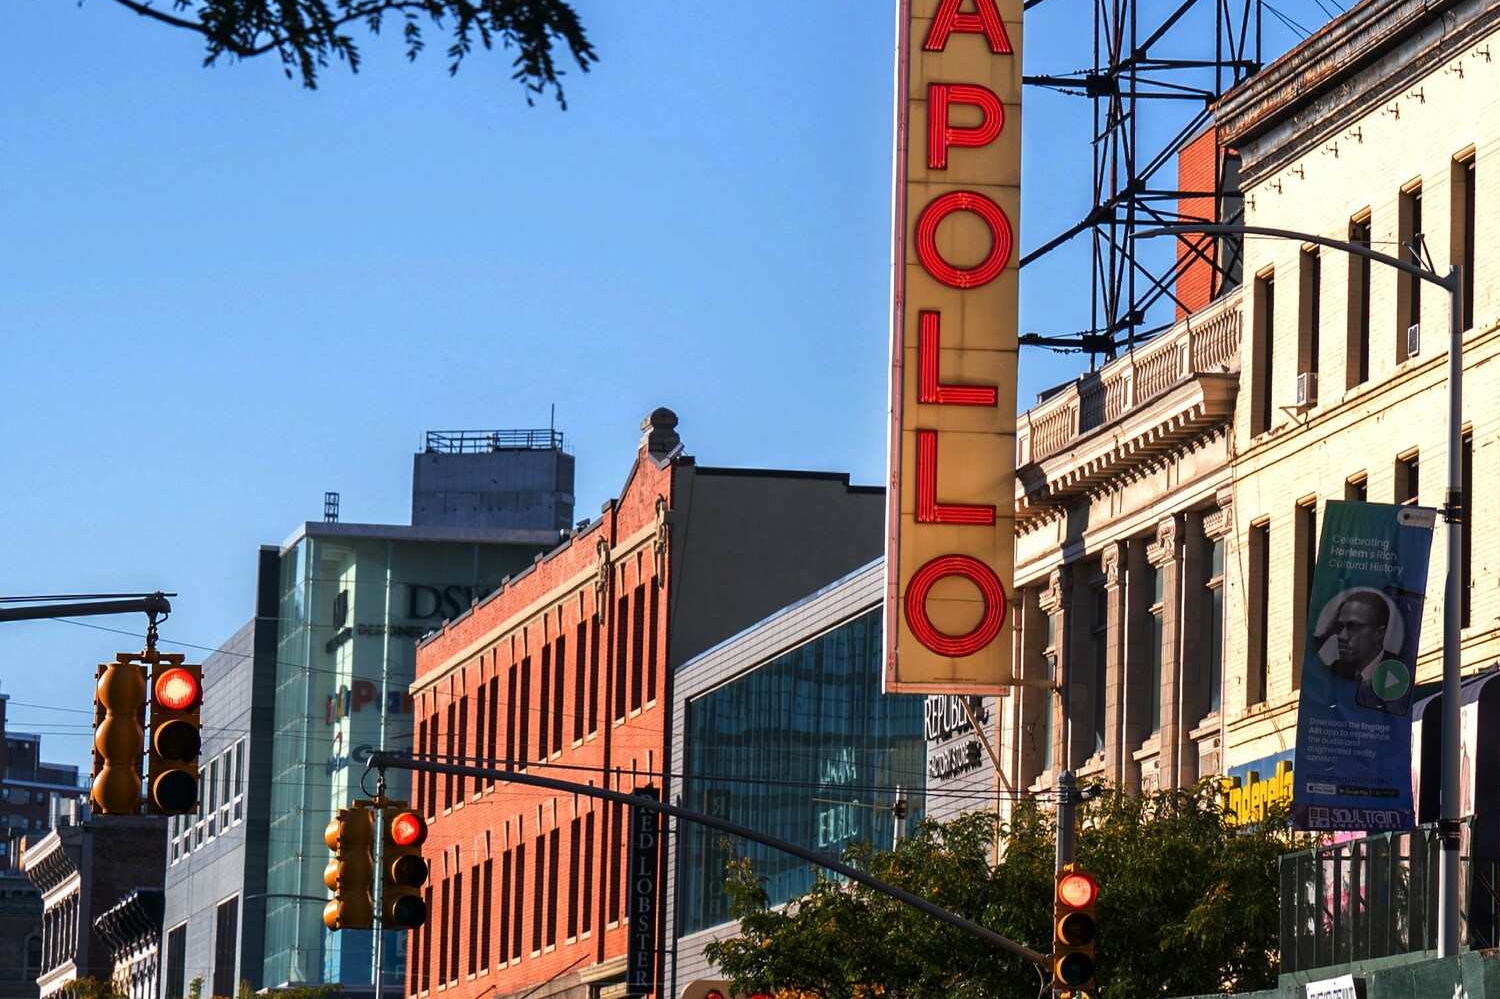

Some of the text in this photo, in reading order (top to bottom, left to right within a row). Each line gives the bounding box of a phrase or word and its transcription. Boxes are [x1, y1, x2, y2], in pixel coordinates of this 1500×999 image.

[1332, 534, 1390, 551] Celebrating
[1330, 546, 1398, 561] Harlem's Rich
[1329, 558, 1404, 577] Cultural History
[1309, 717, 1391, 733] Download the Engage
[1308, 735, 1360, 747] the audio and
[1323, 729, 1339, 738] app
[1349, 732, 1390, 742] experience
[1307, 745, 1377, 760] augmented reality
[1307, 754, 1338, 763] content!
[636, 856, 654, 987] LOBSTER
